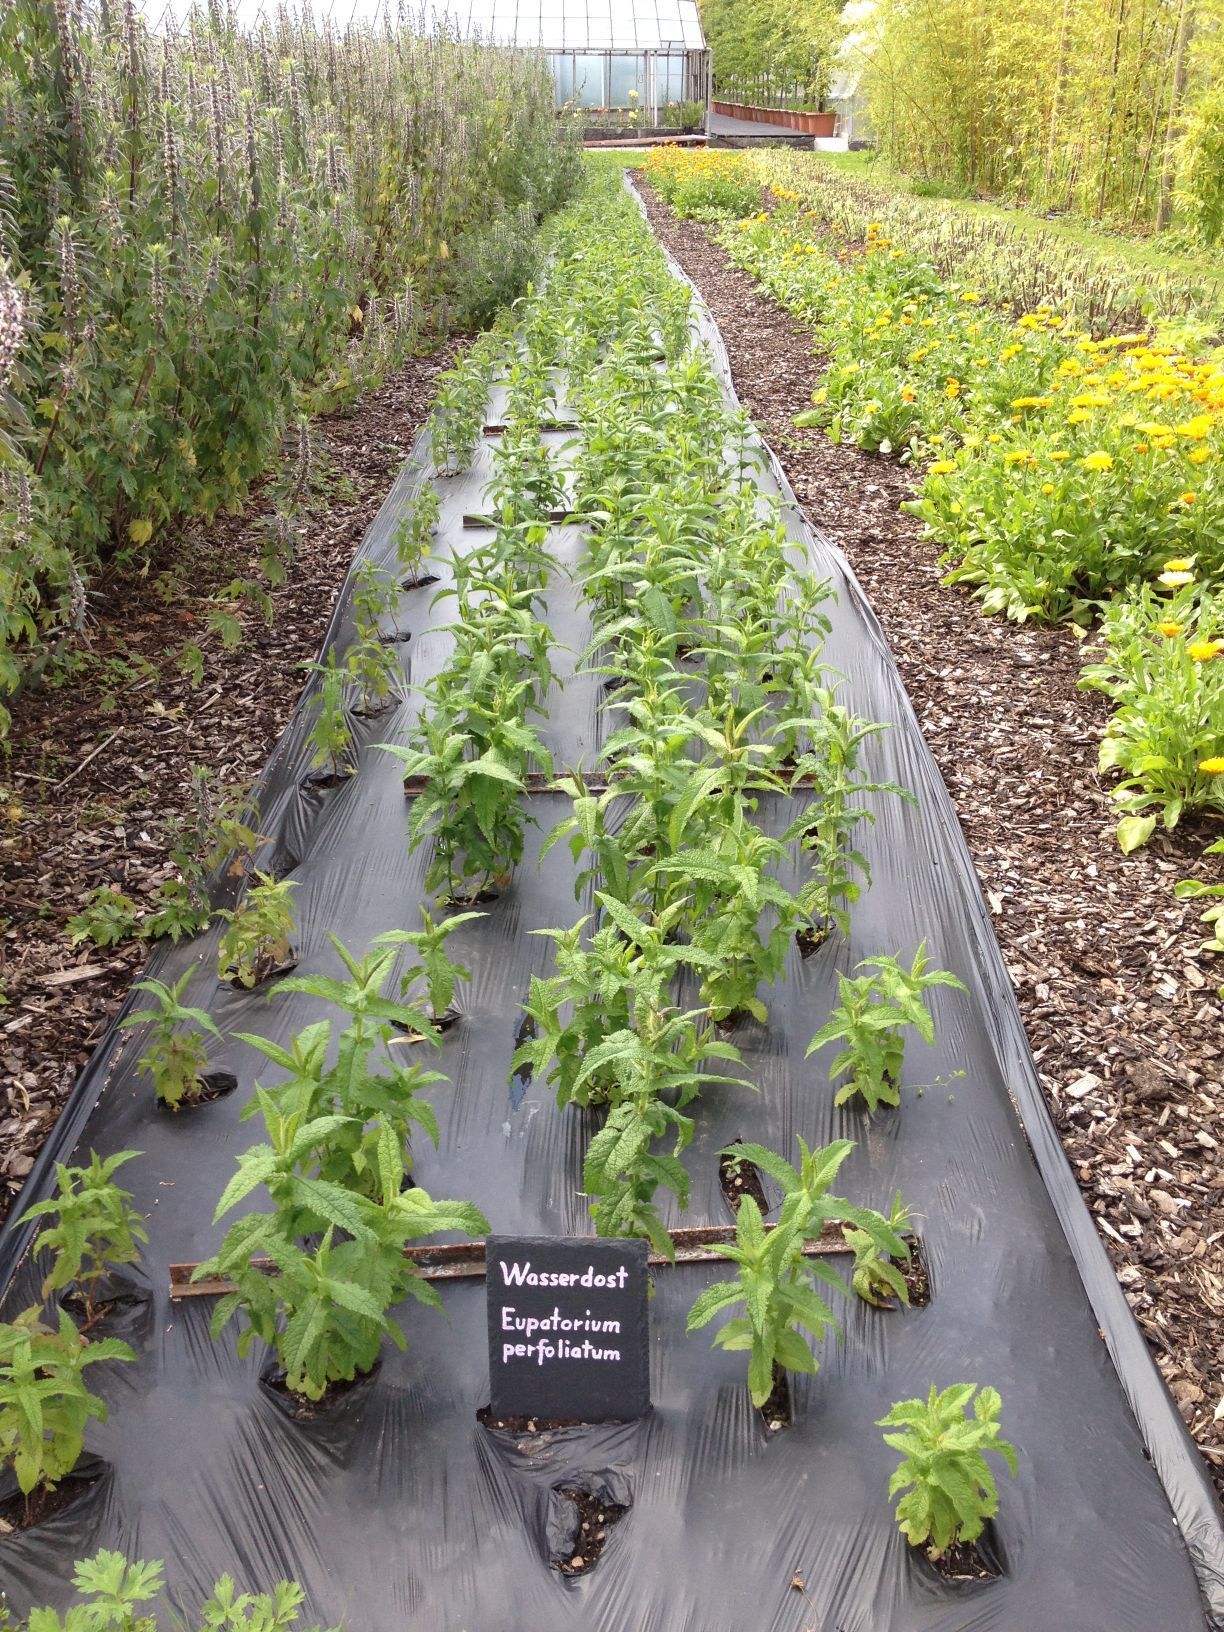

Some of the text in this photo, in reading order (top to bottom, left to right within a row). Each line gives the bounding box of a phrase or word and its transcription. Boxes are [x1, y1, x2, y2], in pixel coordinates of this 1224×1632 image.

[499, 1261, 629, 1288] Wasserdost
[501, 1306, 621, 1337] Eupatorium
[502, 1338, 621, 1366] perfoliatum
